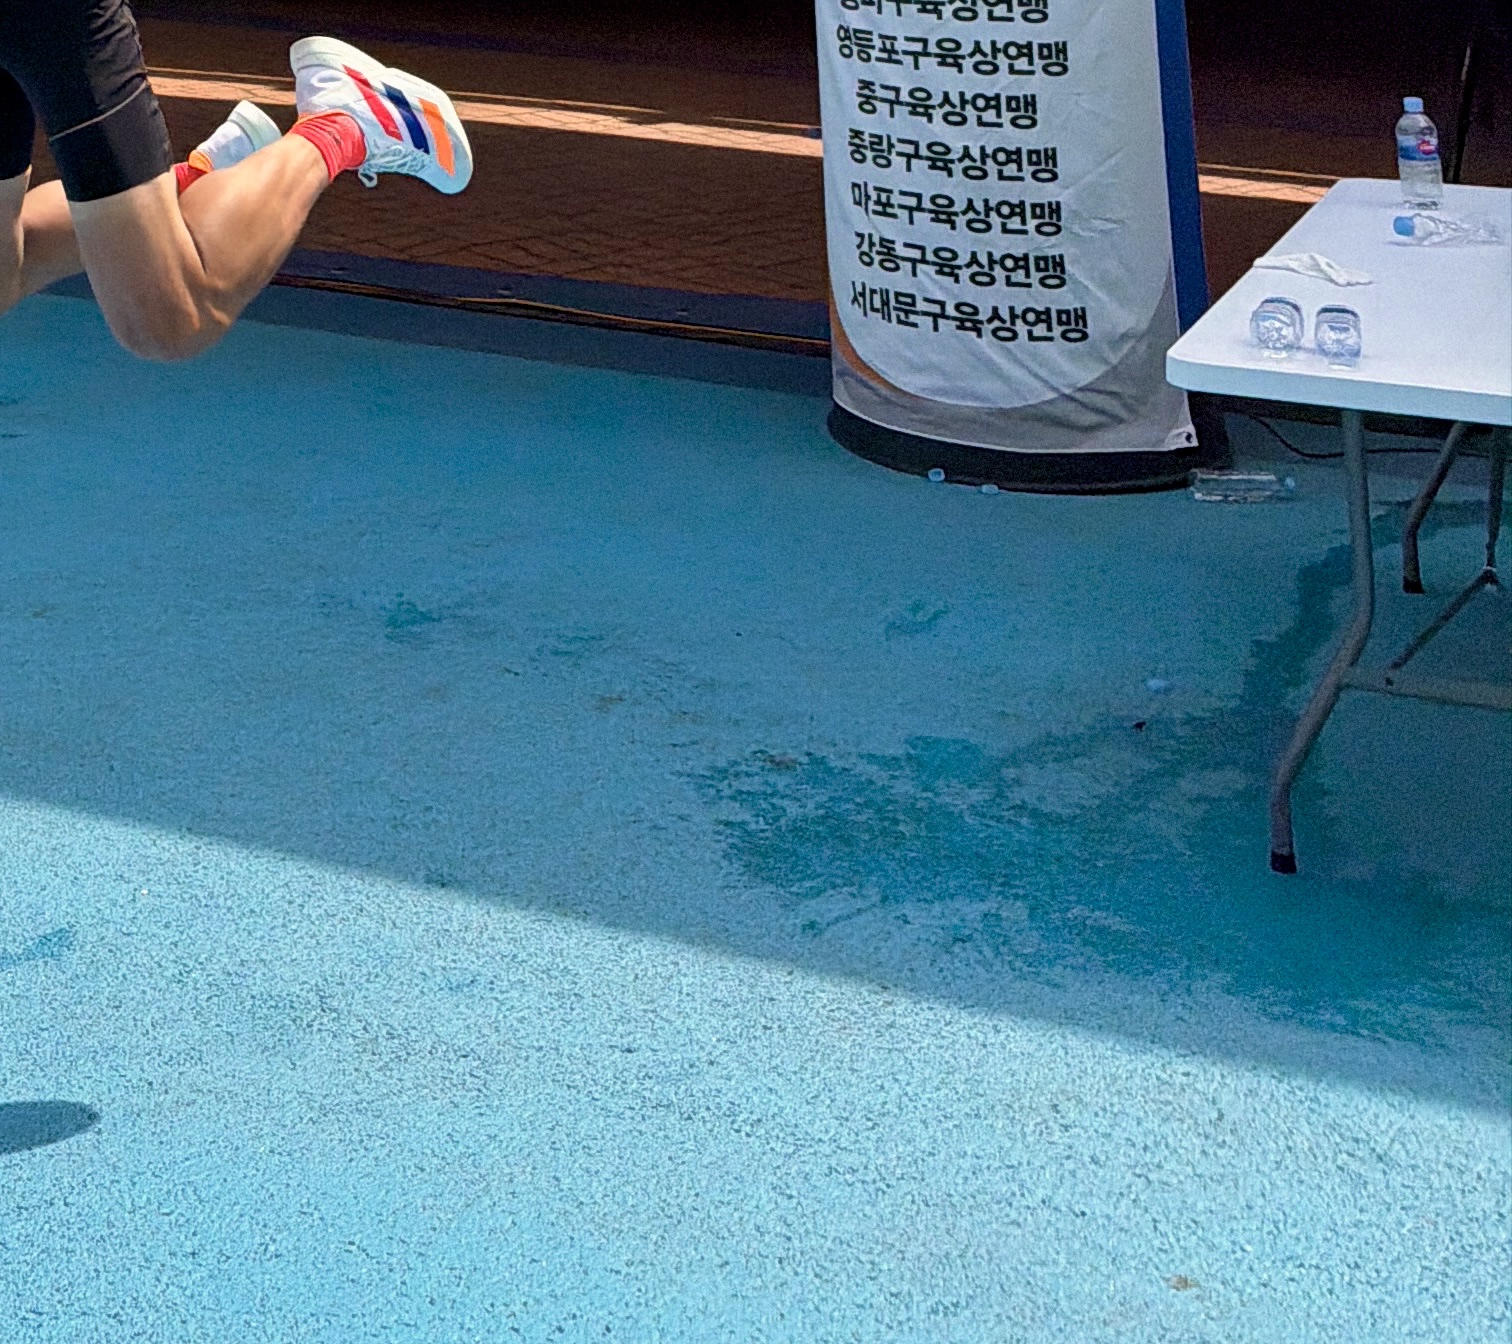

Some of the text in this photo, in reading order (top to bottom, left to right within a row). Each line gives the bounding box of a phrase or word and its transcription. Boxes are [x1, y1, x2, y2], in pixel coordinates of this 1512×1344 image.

[836, 24, 1069, 76] 영등포구육상연맹
[856, 79, 1038, 129] 중구육상연맹
[847, 128, 1059, 183] 중랑구육상연맹
[851, 181, 1062, 237] 마포구육상연맹
[854, 231, 1067, 290] 강동구육상연맹
[850, 279, 1090, 343] 서대문구육상연맹
